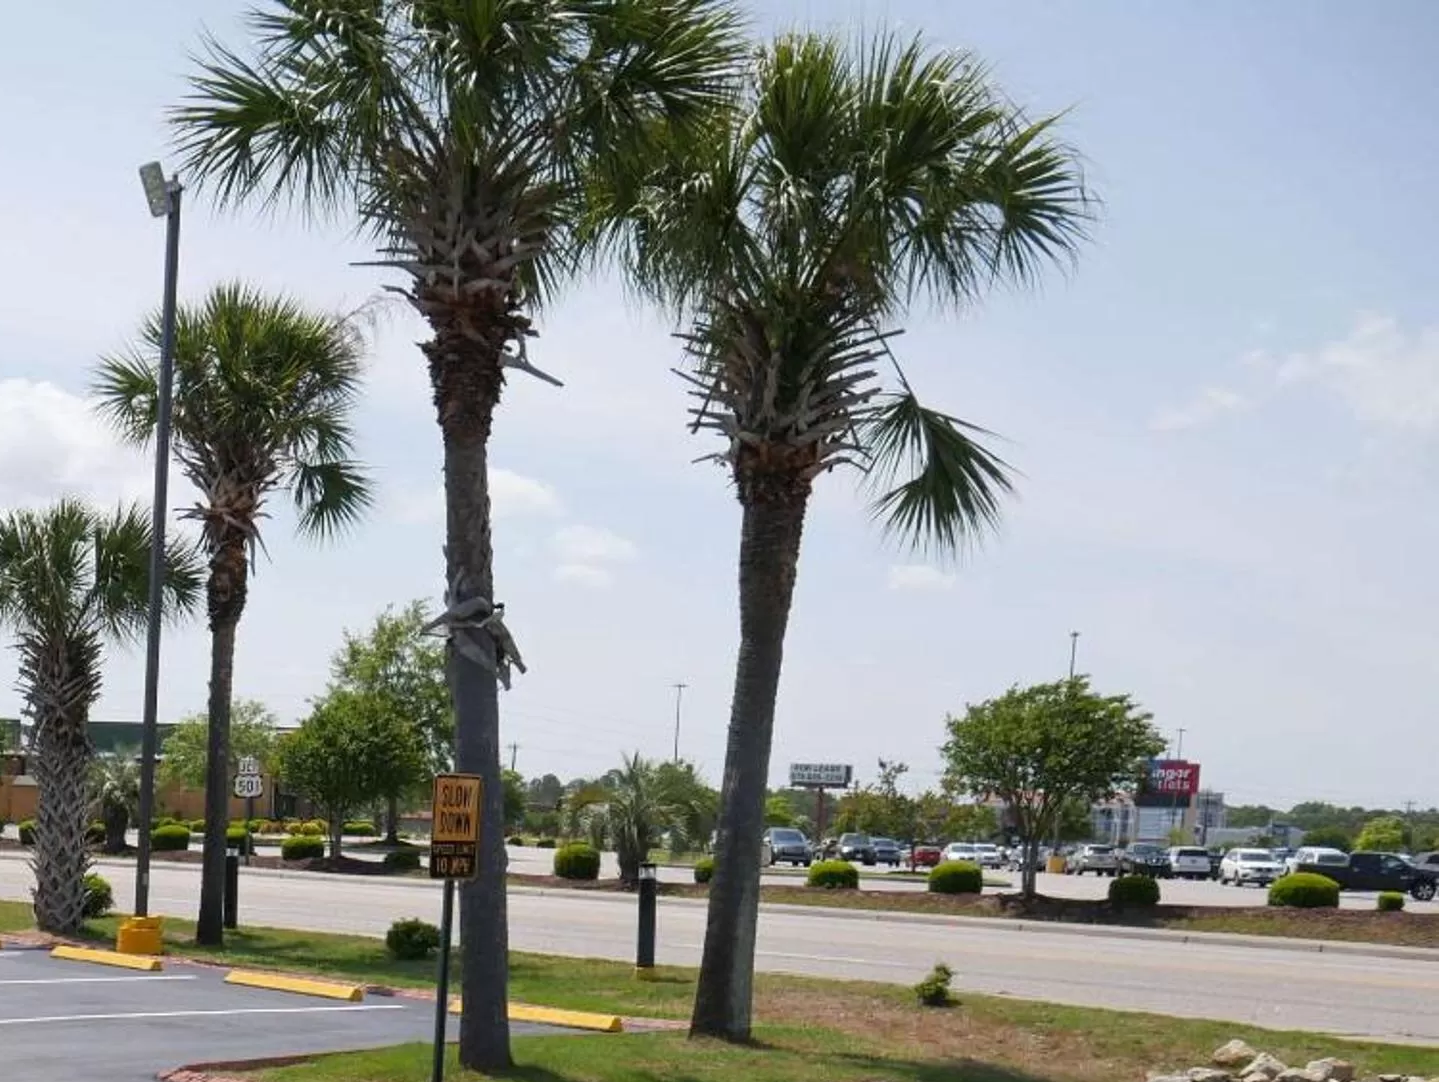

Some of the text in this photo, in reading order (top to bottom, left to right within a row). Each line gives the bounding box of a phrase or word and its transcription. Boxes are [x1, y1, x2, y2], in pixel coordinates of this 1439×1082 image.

[239, 780, 260, 793] 501
[442, 785, 474, 808] SLOW
[440, 811, 472, 836] DOWN
[436, 857, 448, 873] 10
